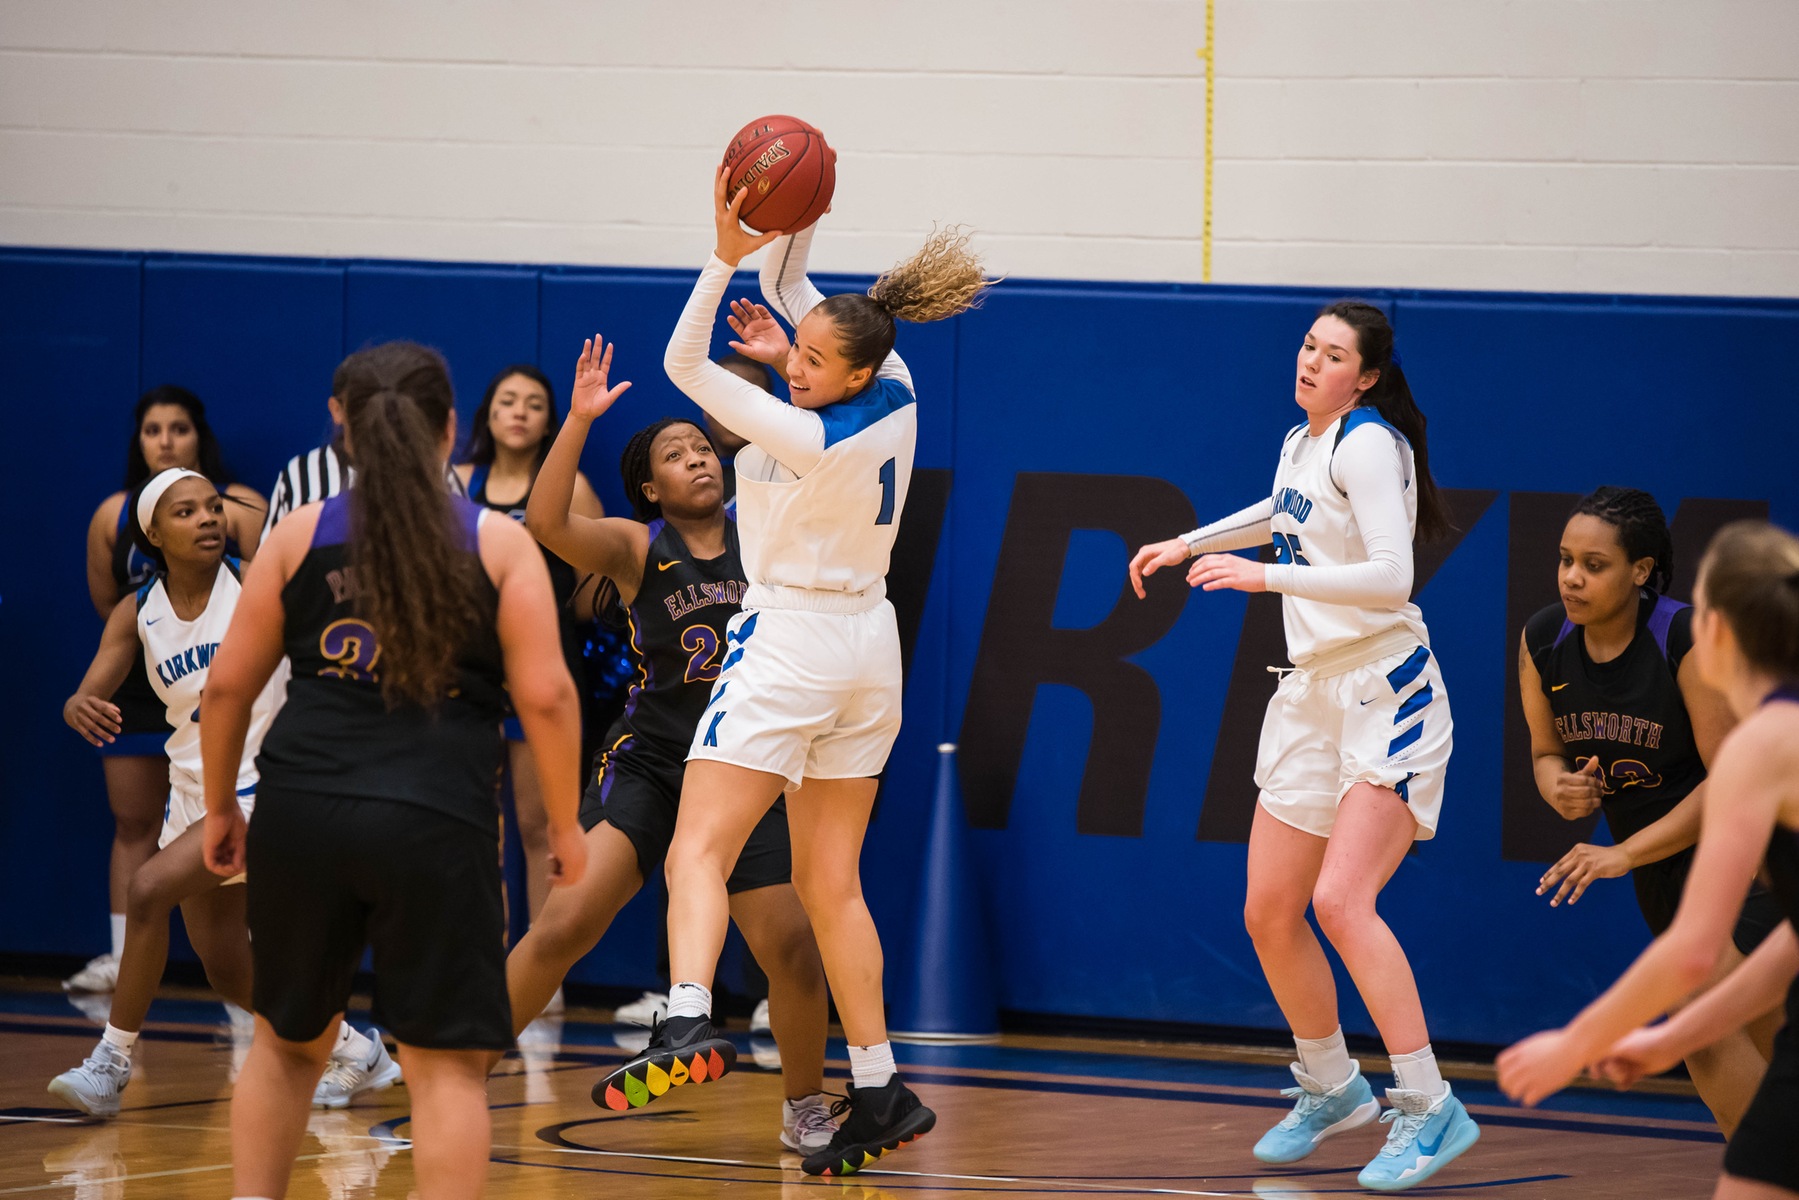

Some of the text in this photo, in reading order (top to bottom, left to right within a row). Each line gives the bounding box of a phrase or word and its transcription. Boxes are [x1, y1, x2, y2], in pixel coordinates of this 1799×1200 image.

[875, 456, 895, 525] 1
[703, 711, 727, 748] K
[1555, 712, 1663, 749] ELLSWORTH
